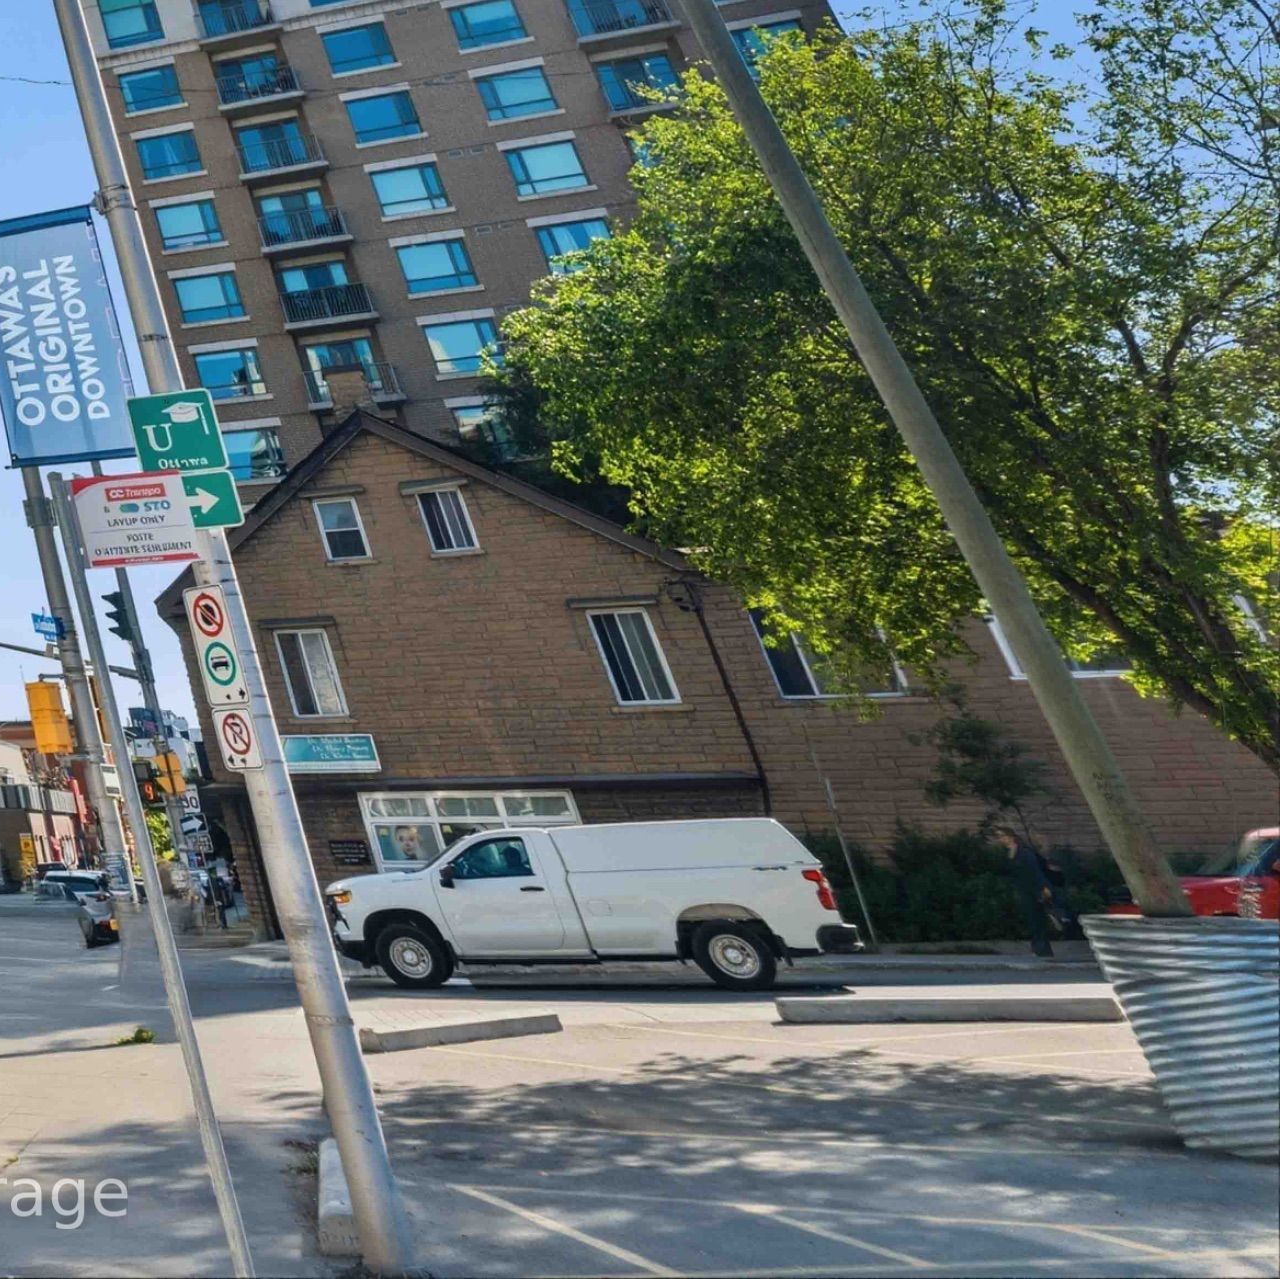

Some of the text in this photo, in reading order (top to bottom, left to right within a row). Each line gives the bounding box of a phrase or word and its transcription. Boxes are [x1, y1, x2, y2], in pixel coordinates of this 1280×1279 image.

[23, 259, 80, 422] ORIGINAL
[52, 254, 111, 420] DOWNTOWN
[142, 423, 172, 452] U
[143, 500, 171, 511] STO
[140, 515, 166, 524] ONLY
[144, 781, 154, 800] 9
